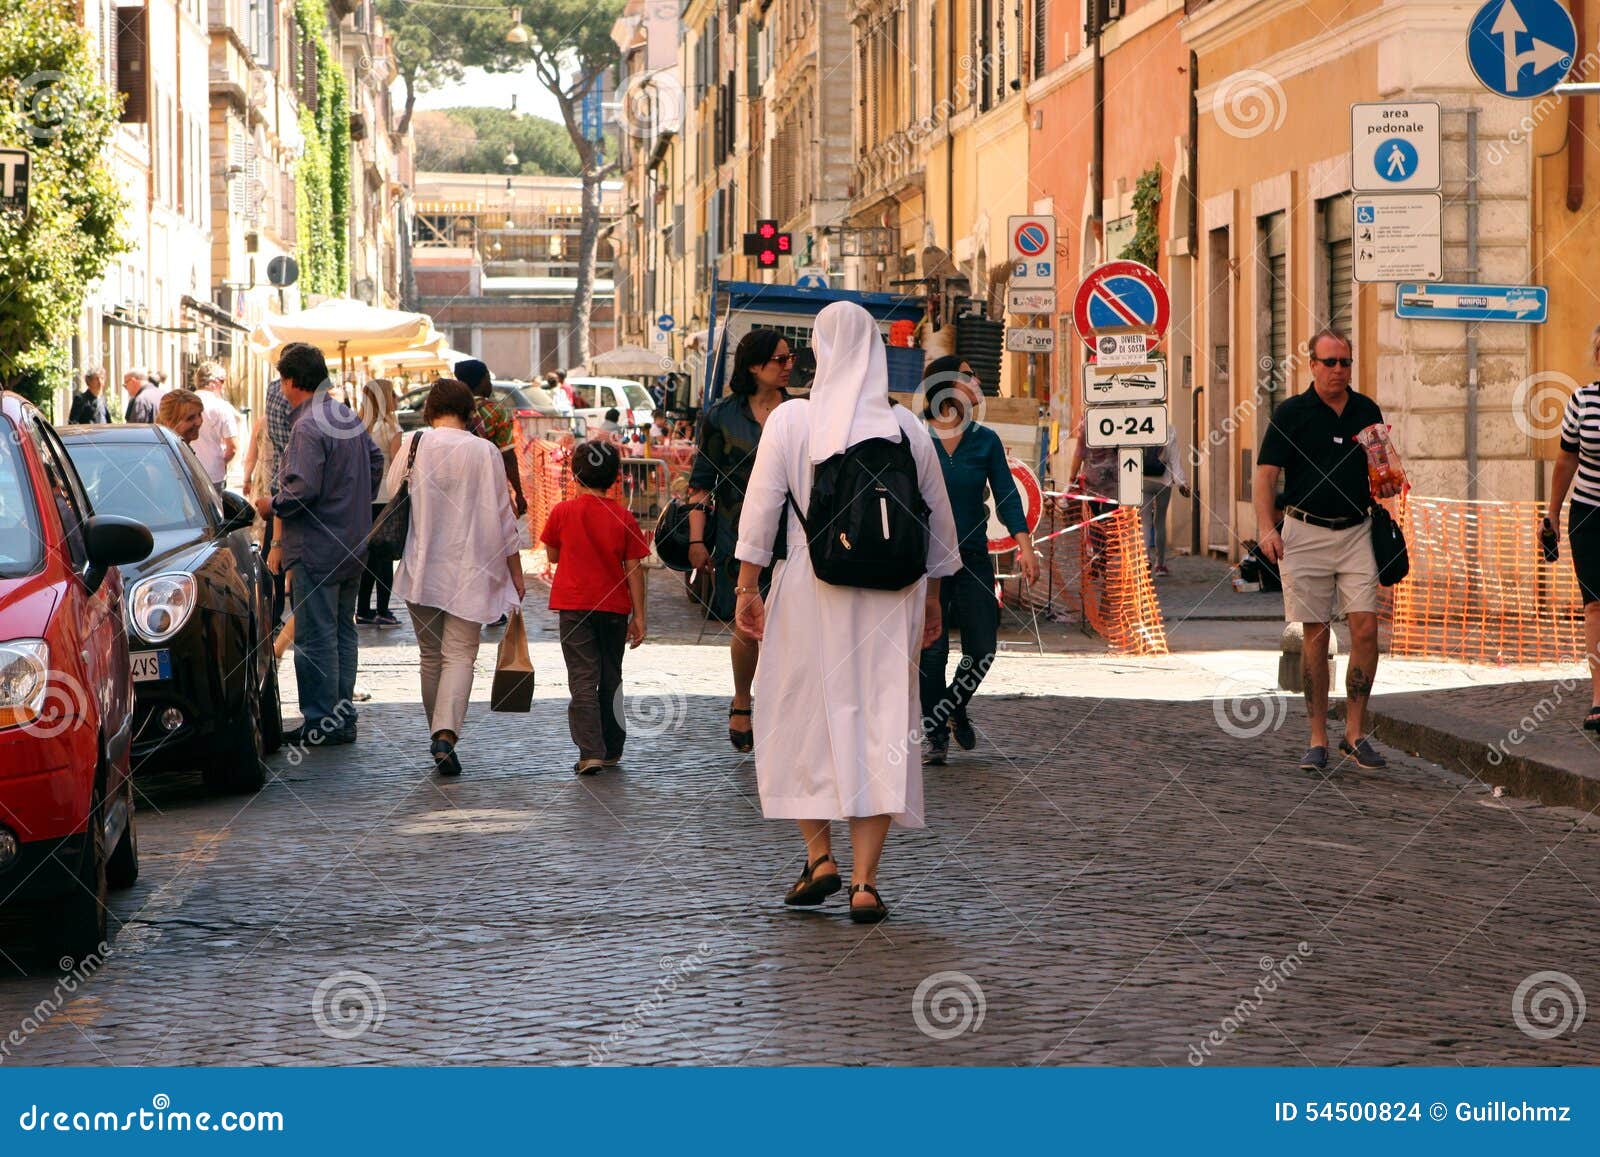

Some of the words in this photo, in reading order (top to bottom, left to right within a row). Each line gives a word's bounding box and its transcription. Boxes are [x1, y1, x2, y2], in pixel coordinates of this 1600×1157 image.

[1382, 110, 1409, 118] area
[1367, 122, 1424, 135] pedonale
[1120, 335, 1143, 343] DIVIETO
[1127, 344, 1145, 353] SOSTA
[1100, 416, 1154, 436] 0-24
